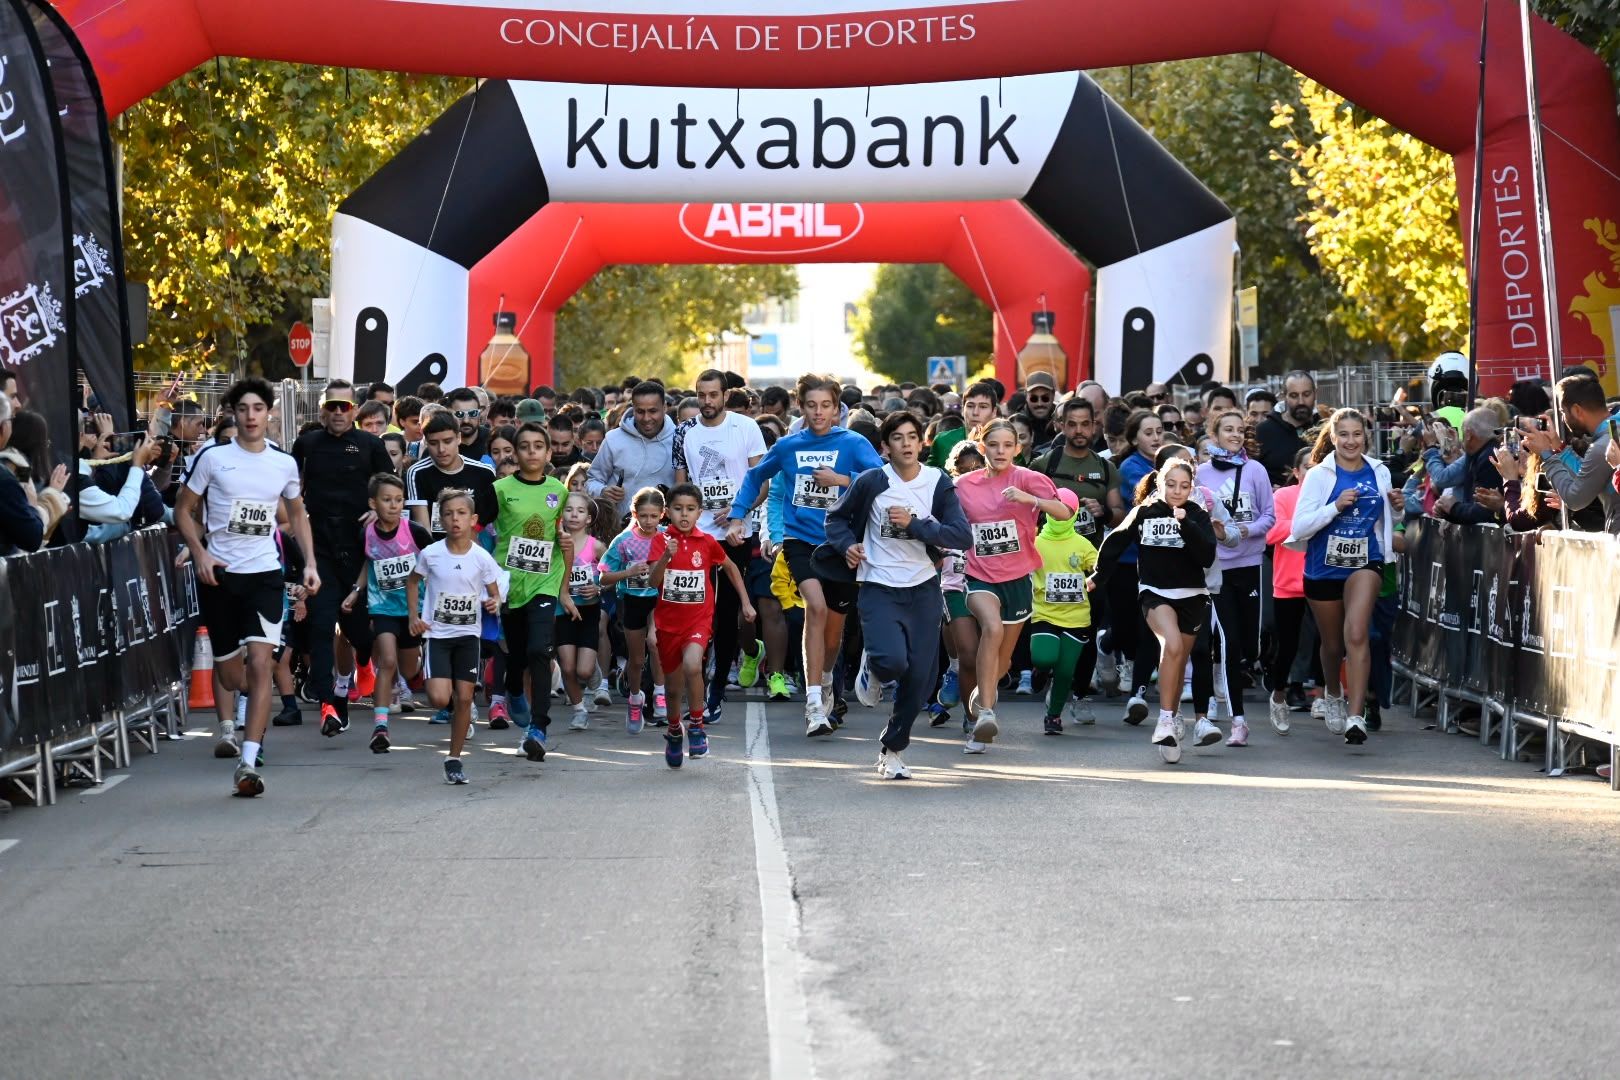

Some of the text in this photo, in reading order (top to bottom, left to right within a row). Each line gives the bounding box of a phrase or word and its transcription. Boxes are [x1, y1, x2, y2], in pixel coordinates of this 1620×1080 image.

[500, 14, 976, 52] CONCEJALÍA DE DEPORTES
[567, 96, 1019, 169] kutxabank
[704, 203, 842, 237] ABRIL
[1492, 165, 1538, 349] DEPORTES
[291, 338, 311, 350] STOP
[703, 485, 729, 497] 5025
[240, 507, 267, 521] 3106
[980, 527, 1008, 540] 3034
[1152, 523, 1179, 535] 3029
[517, 543, 545, 558] 5024
[1335, 542, 1361, 554] 4661
[382, 561, 410, 576] 5206
[569, 570, 587, 582] 963
[673, 576, 699, 588] 4327
[1053, 578, 1078, 589] 3624
[443, 598, 472, 611] 5334
